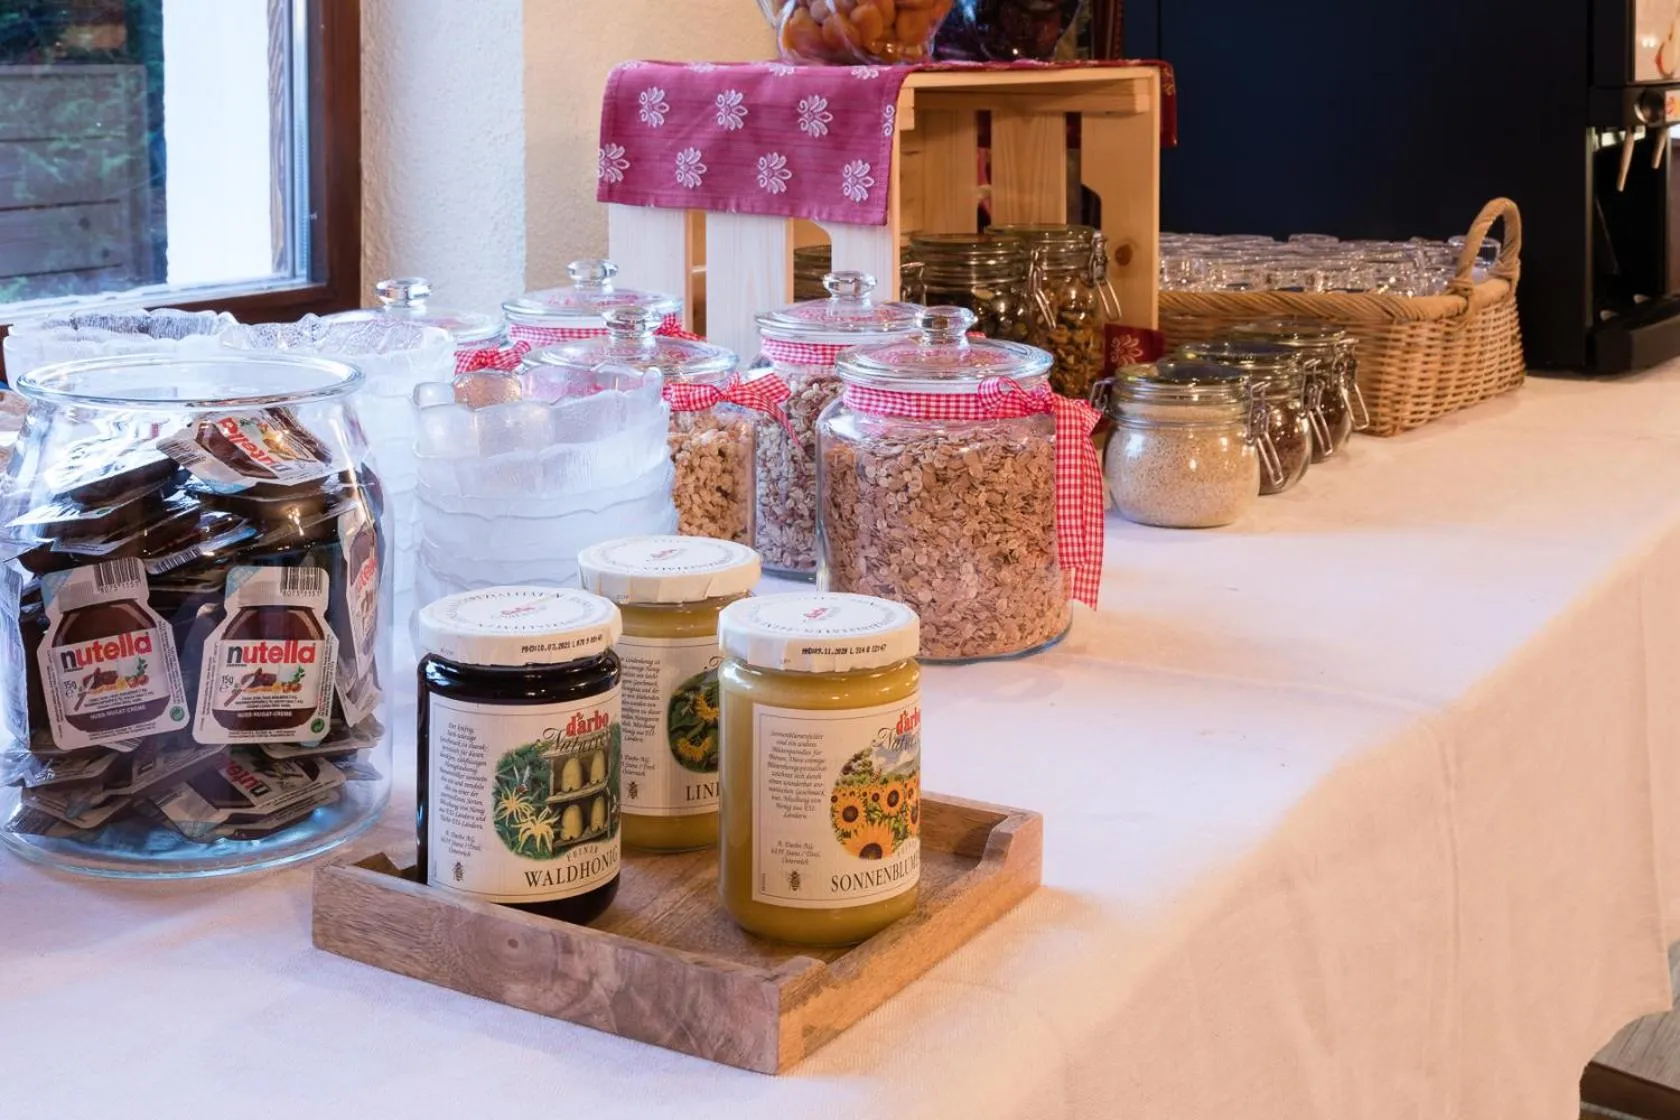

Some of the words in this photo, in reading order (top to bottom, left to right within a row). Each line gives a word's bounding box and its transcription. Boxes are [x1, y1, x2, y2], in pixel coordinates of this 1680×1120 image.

[219, 416, 292, 472] nutella
[60, 632, 153, 670] nutella
[227, 640, 317, 664] nutella
[524, 844, 618, 888] WALDHONIG
